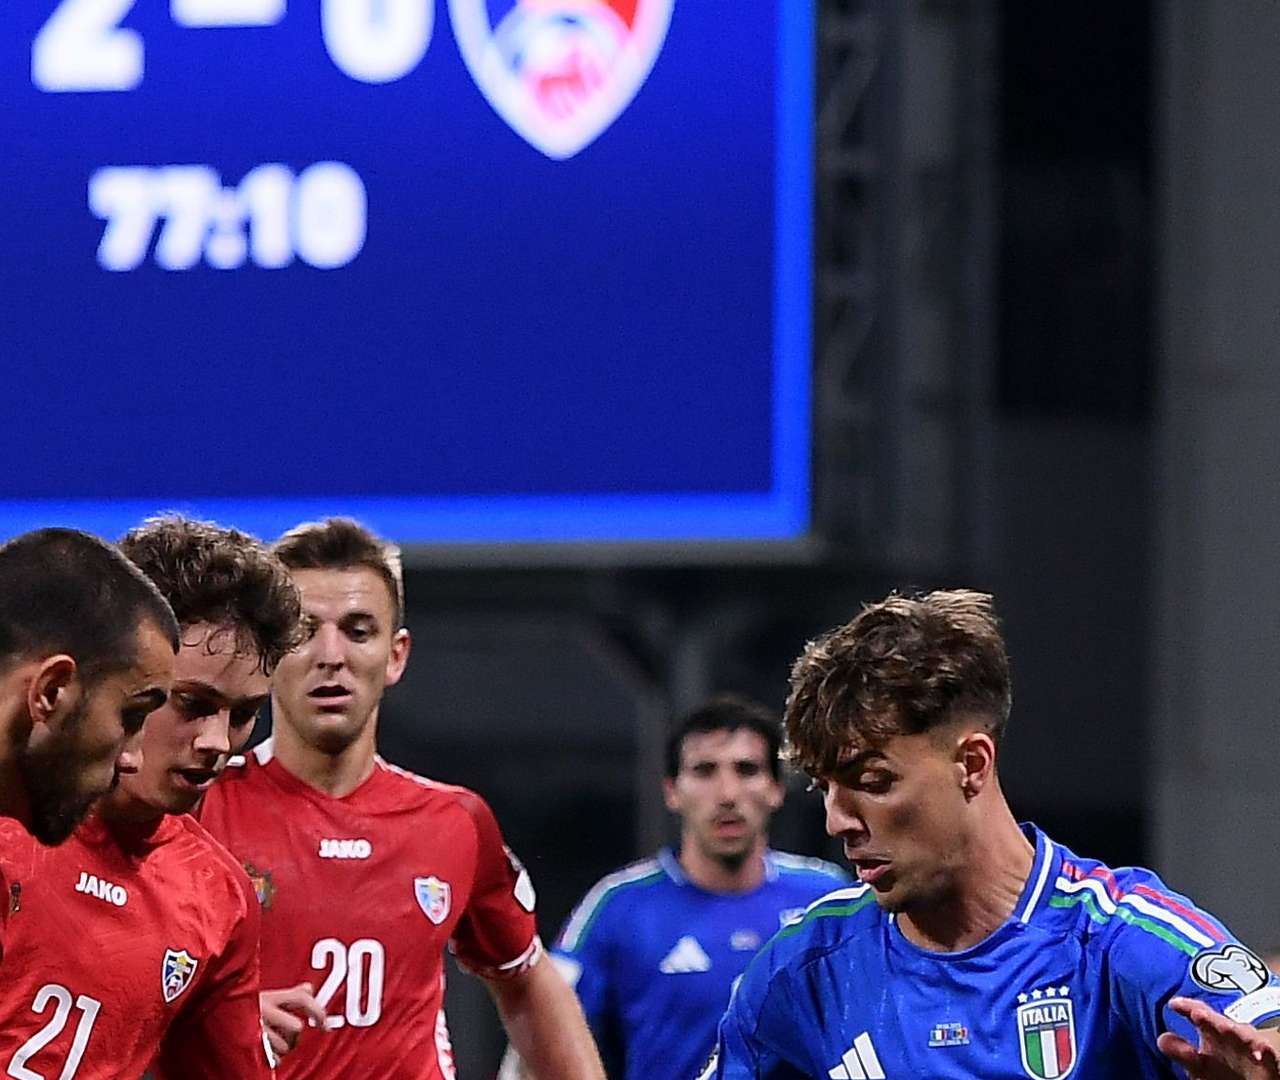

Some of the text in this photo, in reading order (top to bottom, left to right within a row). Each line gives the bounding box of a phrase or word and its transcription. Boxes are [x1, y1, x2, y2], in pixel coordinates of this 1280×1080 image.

[317, 839, 371, 858] JAKO
[75, 872, 128, 906] JAKO
[308, 937, 385, 1029] 20
[1022, 1006, 1068, 1026] ITALIA
